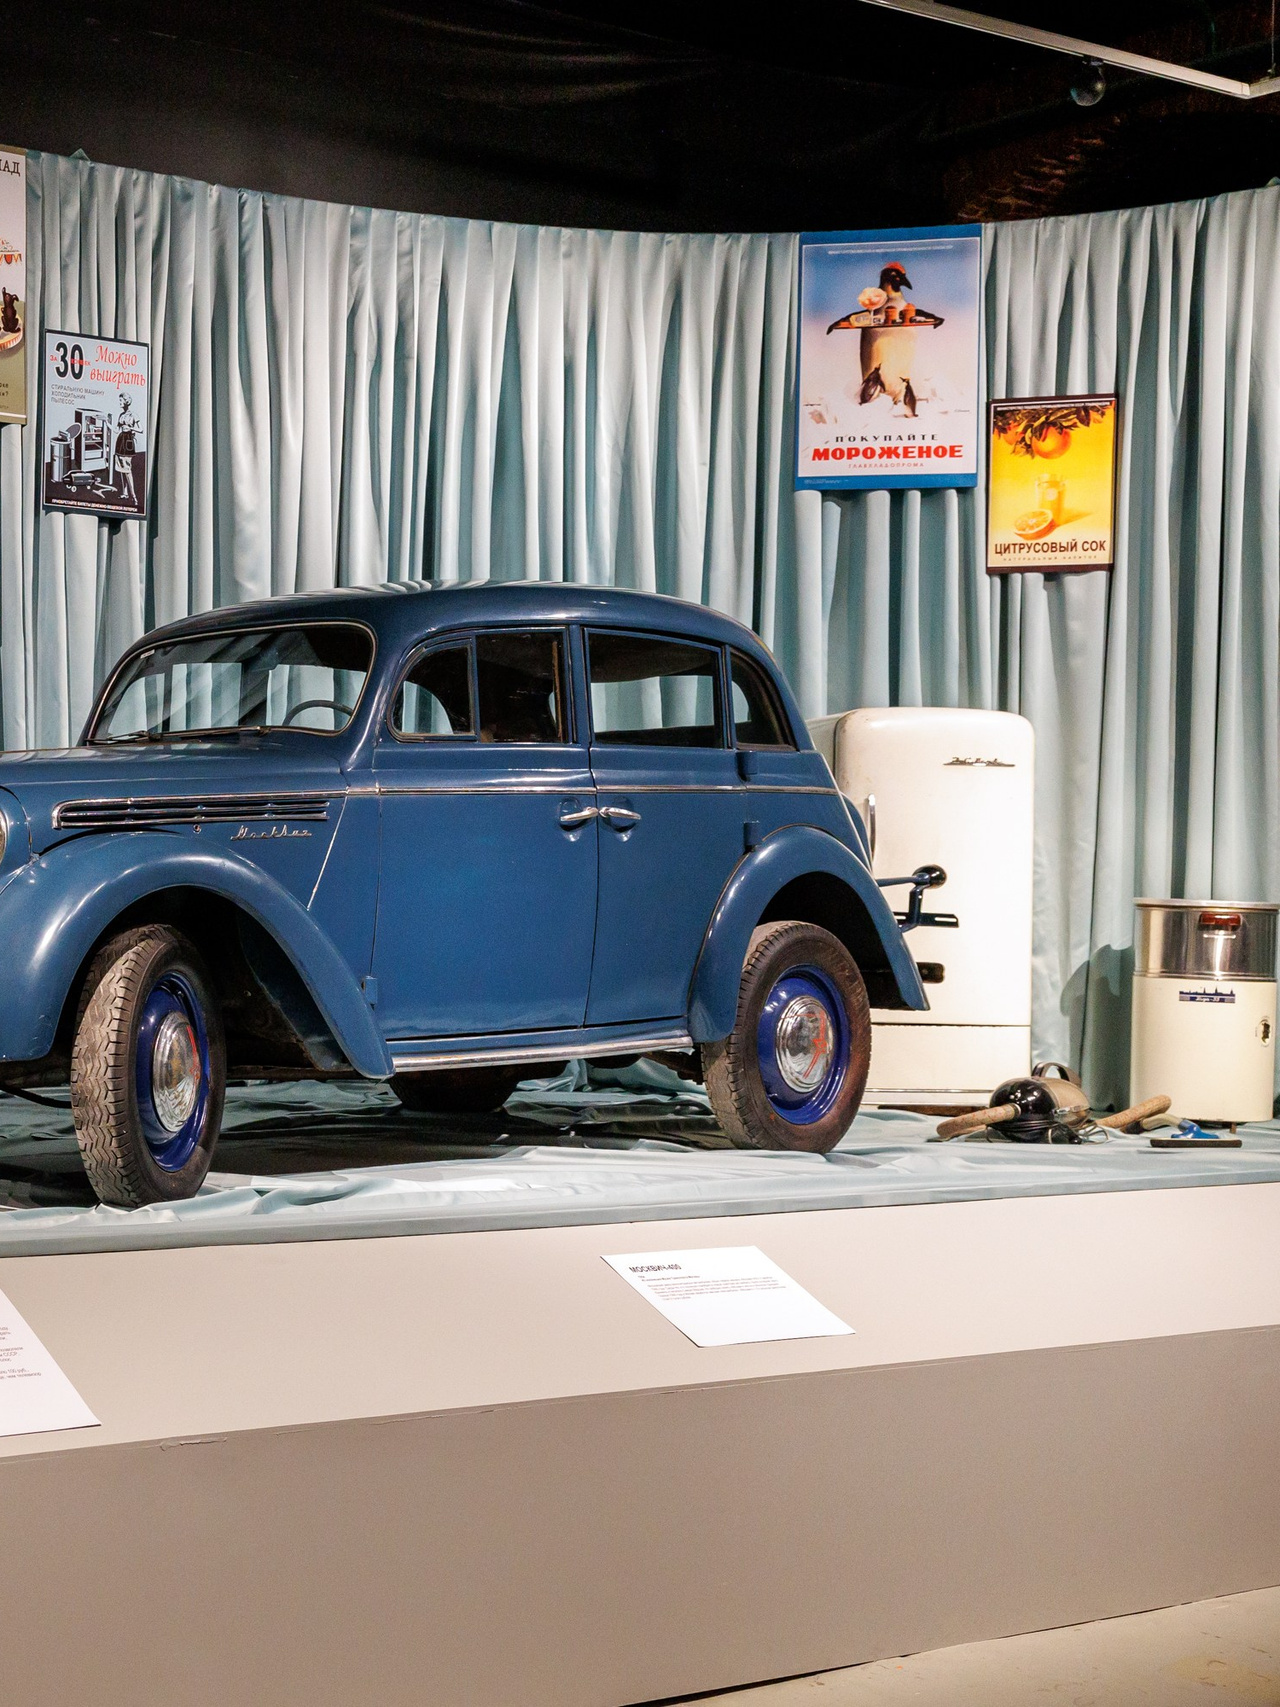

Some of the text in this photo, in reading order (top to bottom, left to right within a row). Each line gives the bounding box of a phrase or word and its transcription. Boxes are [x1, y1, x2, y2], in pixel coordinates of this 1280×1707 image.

[55, 341, 84, 380] 30
[95, 344, 137, 370] Можно
[90, 367, 146, 390] выиграть
[835, 433, 938, 443] ПОКУПАЙТЕ
[811, 444, 964, 461] МОРОЖЕНОЕ
[994, 539, 1106, 556] ЦИТРУСОВЫЙ СОК
